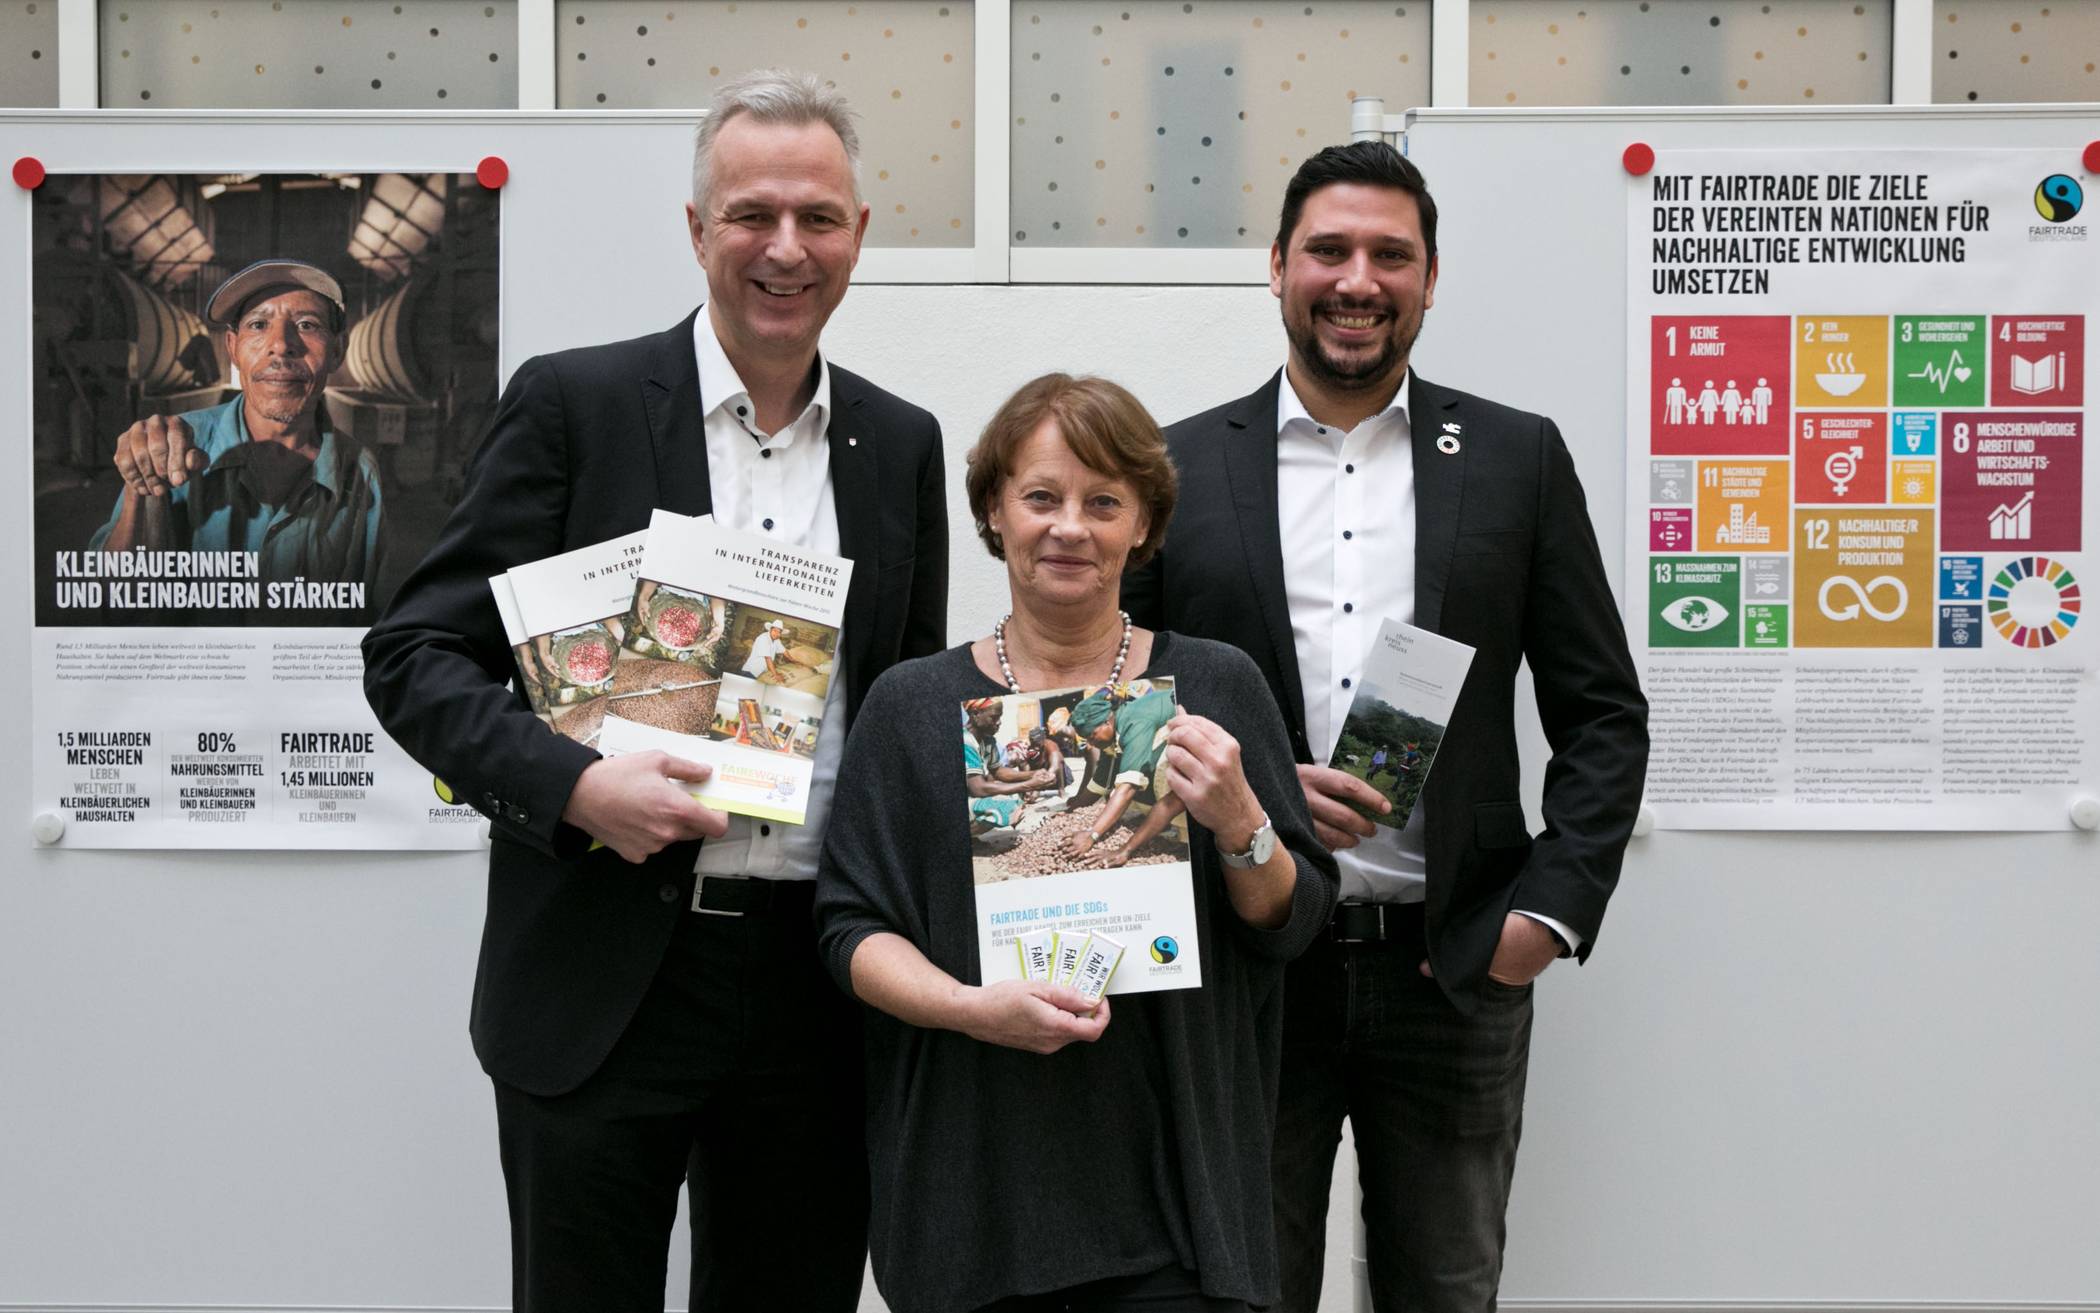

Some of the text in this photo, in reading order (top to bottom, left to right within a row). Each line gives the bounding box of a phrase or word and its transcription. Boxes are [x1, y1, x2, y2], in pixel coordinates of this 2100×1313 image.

[1653, 175, 1928, 200] MIT FAIRTRADE DIE ZIELE
[1653, 201, 1989, 232] DER VEREINTEN NATIONEN FÜR
[2029, 226, 2087, 236] FAIRTRADE
[1653, 238, 1965, 264] NACHHALTIGE ENTWICKLUNG
[1653, 269, 1768, 294] UMSETZEN
[1690, 326, 1719, 340] KEINE
[1804, 322, 1814, 342] 2
[1902, 322, 1912, 342] 3
[2000, 322, 2010, 342] 4
[1666, 326, 1677, 356] 1
[1690, 342, 1726, 356] ARMUT
[1803, 419, 1814, 439] 5
[1977, 421, 2076, 436] MENSCHENWÜRDIGE
[1953, 422, 1970, 453] 8
[1977, 440, 2035, 453] ARBEIT UND
[1977, 456, 2050, 470] WIRTSCHAFTS-
[1704, 467, 1718, 488] 11
[1977, 472, 2034, 486] WACHSTUM
[1838, 519, 1918, 534] NACHHALTIGE/R
[1804, 520, 1829, 550] 12
[1838, 536, 1904, 550] KONSUM UND
[56, 546, 259, 578] KLEINBÄUERINNEN
[762, 548, 840, 576] TRANSPARENZ
[1838, 552, 1904, 566] PRODUKTION
[715, 548, 836, 587] IN INTERNATIONALEN
[1654, 563, 1672, 584] 13
[584, 571, 596, 580] IN
[756, 570, 834, 598] LIEFERKETTEN
[56, 577, 366, 609] UND KLEINBAUERN STÄRKEN
[58, 732, 150, 747] 1,5 MILLIARDEN
[198, 732, 236, 752] 80%
[281, 734, 374, 753] FAIRTRADE
[68, 750, 142, 765] MENSCHEN
[290, 756, 365, 768] ARBEITET MIT
[90, 768, 120, 780] LEBEN
[171, 764, 264, 776] NAHRUNGSMITTEL
[281, 772, 374, 788] 1,45 MILLIONEN
[74, 783, 136, 794] WELTWEIT IN
[180, 786, 255, 798] KLEINBÄUERINNEN
[289, 787, 366, 799] KLEINBÄUERINNEN
[60, 794, 150, 808] KLEINBÄUERLICHEN
[180, 800, 255, 809] UND KLEINBAUERN
[319, 801, 336, 810] UND
[76, 811, 134, 822] HAUSHALTEN
[188, 811, 247, 822] PRODUZIERT
[299, 812, 356, 822] KLEINBAUERN
[990, 900, 1108, 925] FAIRTRADE UND DIE SDGs
